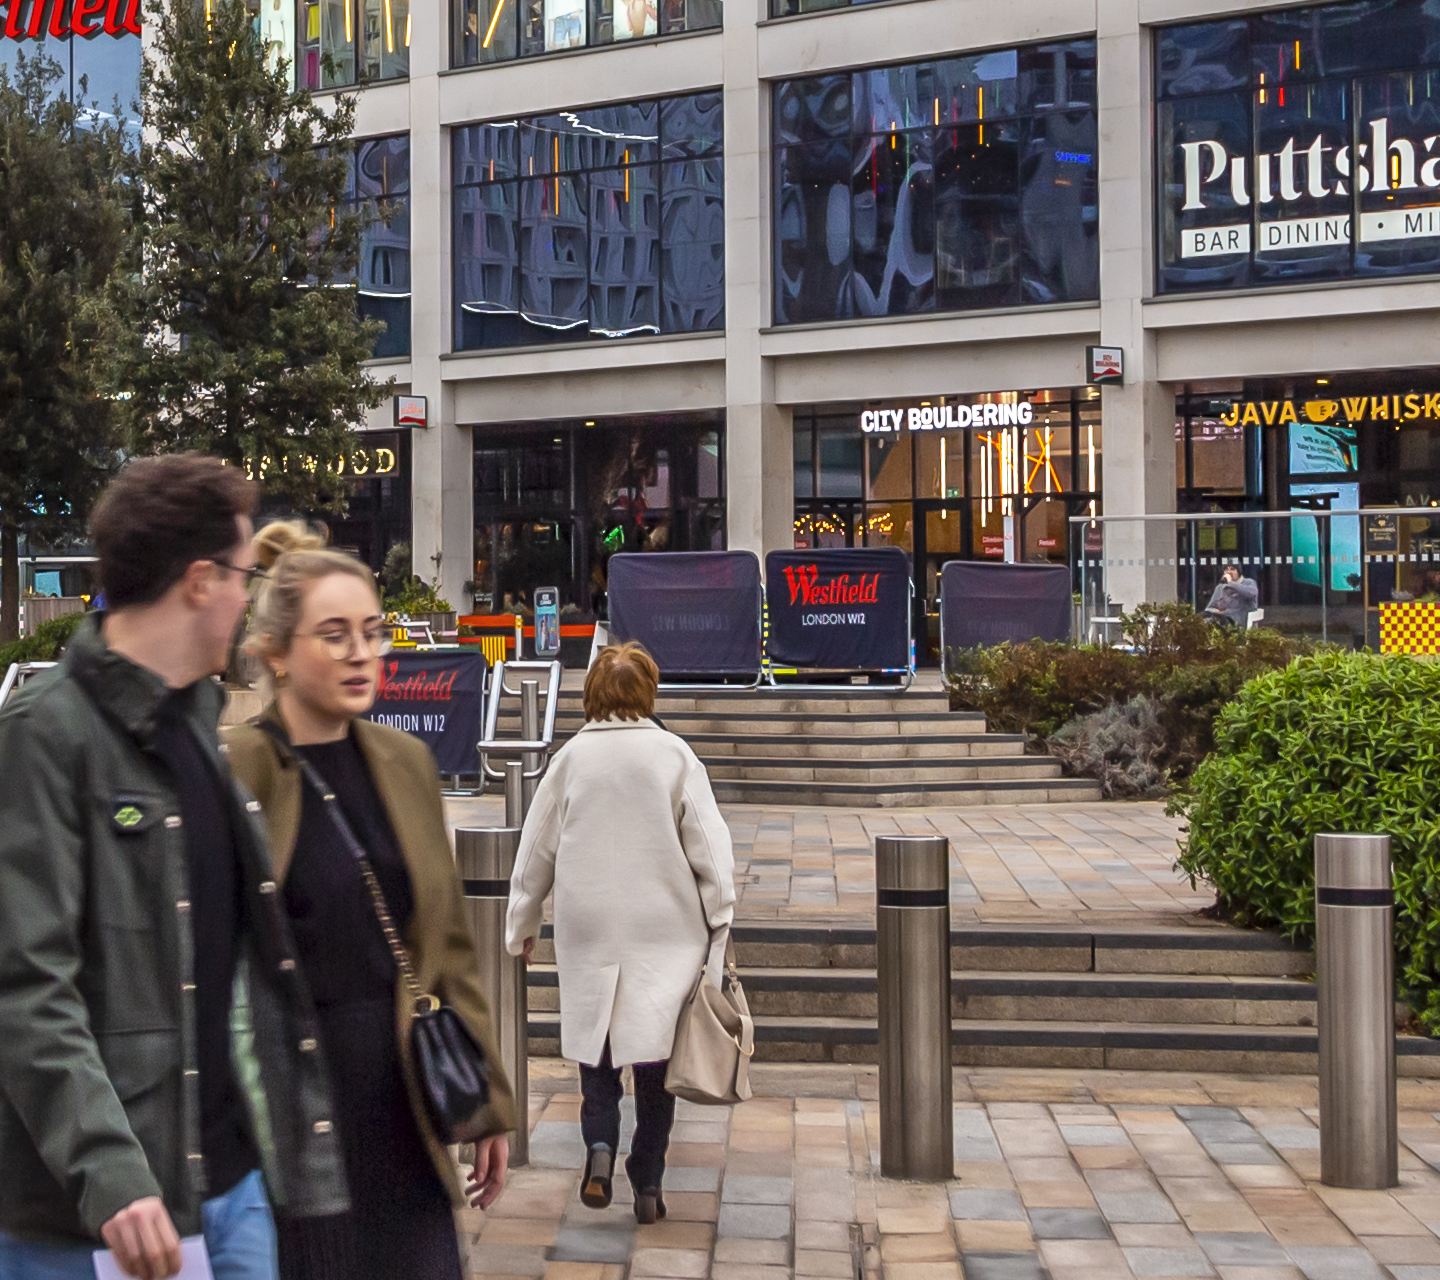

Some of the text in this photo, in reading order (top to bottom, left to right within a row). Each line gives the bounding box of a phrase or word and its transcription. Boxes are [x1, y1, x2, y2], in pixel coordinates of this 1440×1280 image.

[1194, 229, 1241, 253] BAR
[861, 402, 1033, 433] CITY BOULDERING
[1223, 400, 1298, 427] JAVA
[781, 564, 882, 606] Westfield
[802, 612, 866, 627] LONDON W12
[423, 714, 445, 732] W12
